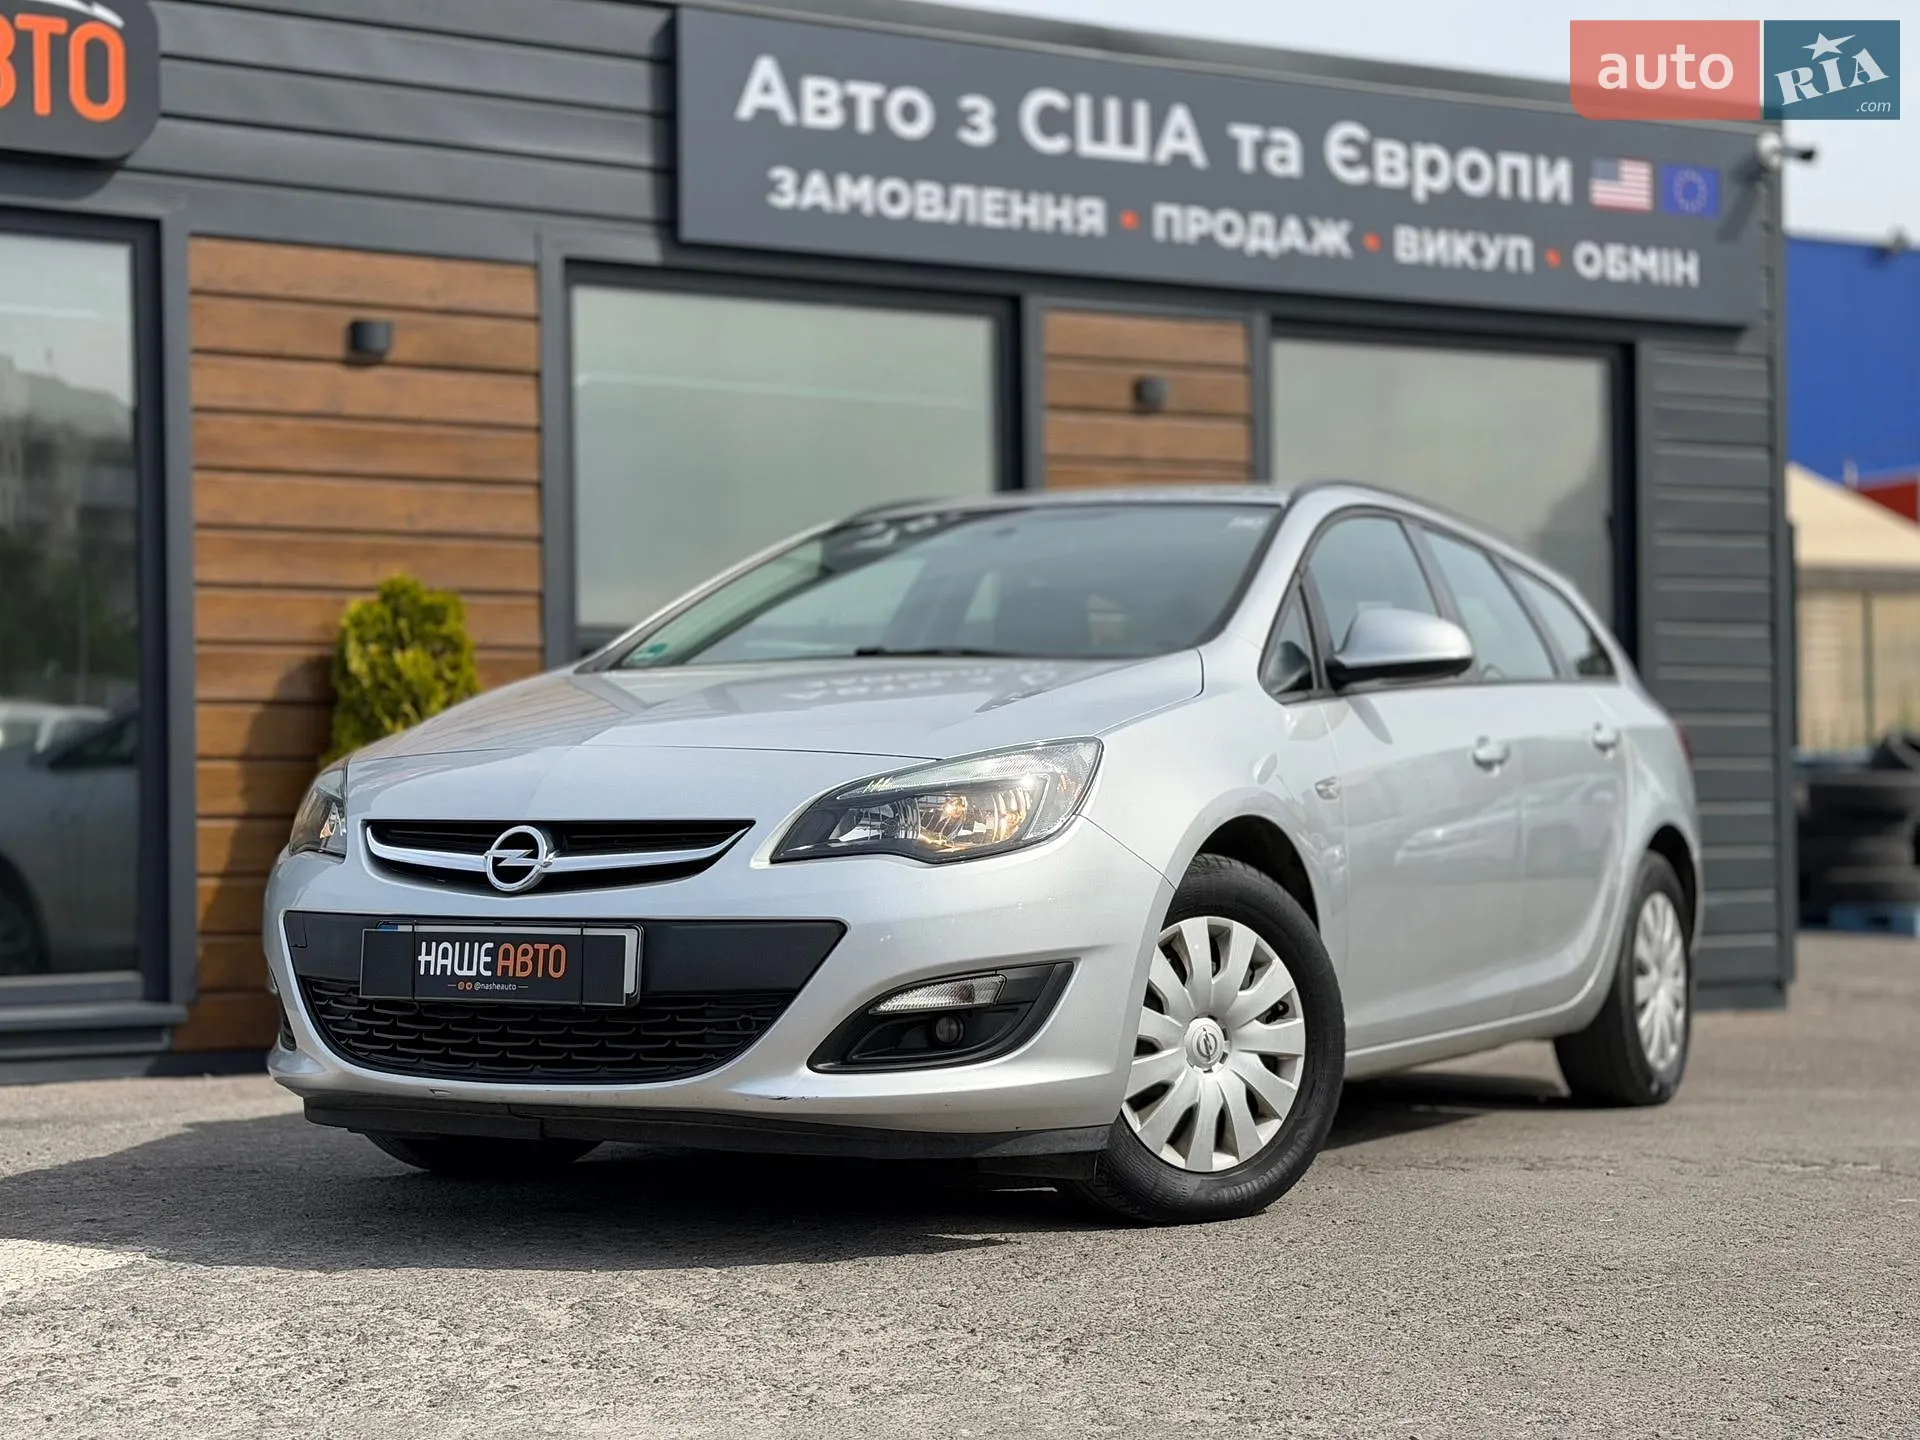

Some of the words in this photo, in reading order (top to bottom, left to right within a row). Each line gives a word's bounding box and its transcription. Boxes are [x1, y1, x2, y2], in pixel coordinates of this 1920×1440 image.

[734, 54, 936, 140] Авто
[956, 93, 997, 147] з
[1019, 87, 1208, 169] США
[1227, 122, 1303, 179] та
[1323, 120, 1573, 205] Європи
[767, 165, 1107, 237] ЗАМОВЛЕННЯ
[1152, 202, 1352, 259] ПРОДАЖ
[1393, 224, 1534, 274] ВИКУП
[1573, 241, 1700, 287] ОБМІН
[417, 941, 494, 977] НАШЕ
[496, 943, 567, 979] АВТО
[473, 981, 517, 991] @nasheauto
